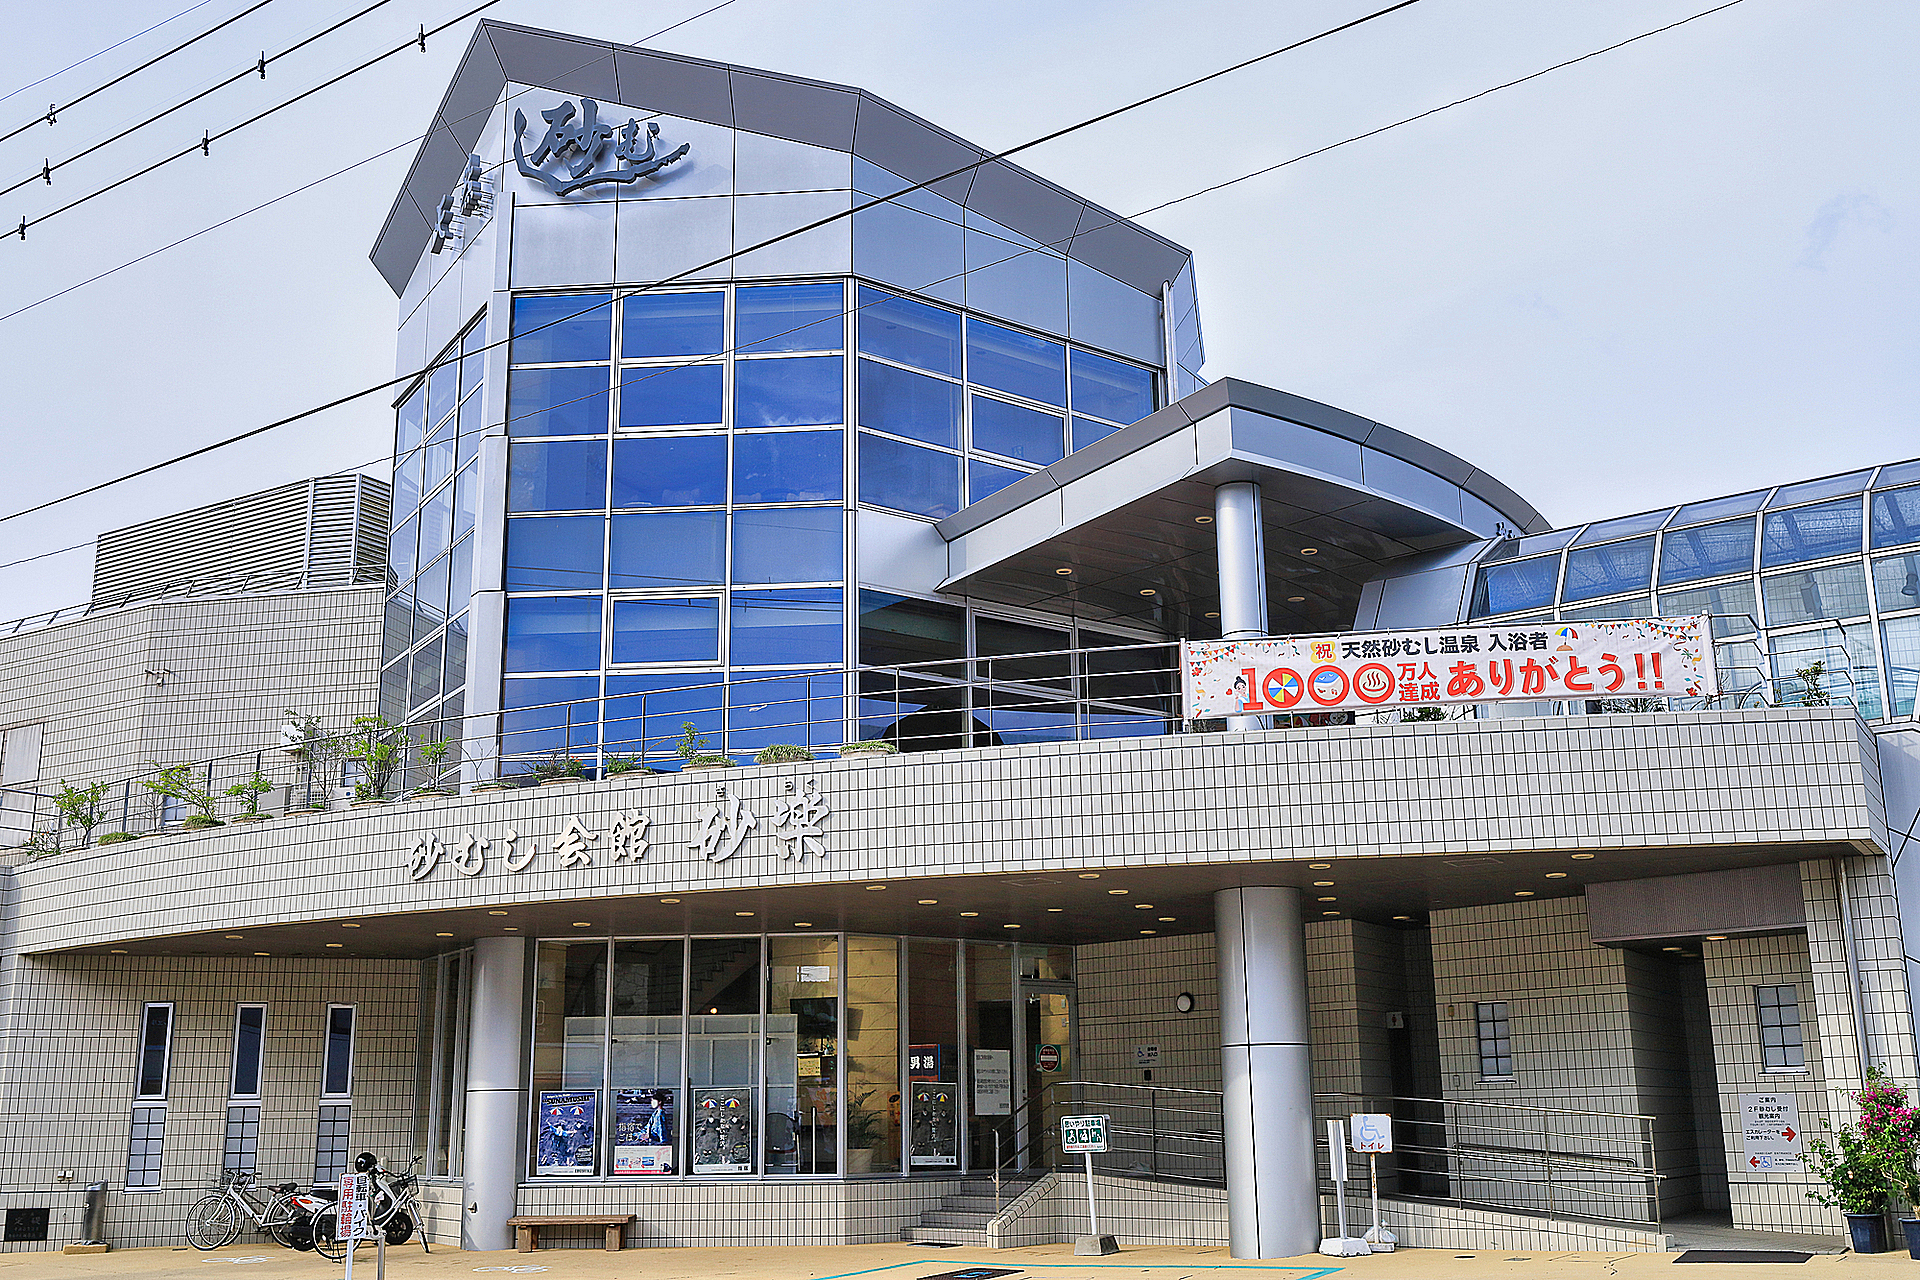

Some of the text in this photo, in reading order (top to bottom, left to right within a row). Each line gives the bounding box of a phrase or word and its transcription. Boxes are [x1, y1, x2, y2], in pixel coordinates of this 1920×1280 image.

[1315, 643, 1333, 659] 祝
[1341, 631, 1549, 659] 天然砂むし温泉 入浴者
[1396, 661, 1438, 681] 万人
[1398, 682, 1441, 702] 達成
[687, 788, 830, 864] 砂楽
[402, 809, 651, 881] 砂むし会館
[1361, 1142, 1385, 1150] トイレ
[340, 1176, 354, 1238] 専用駐輪場
[353, 1175, 368, 1237] 自転車・バイク
